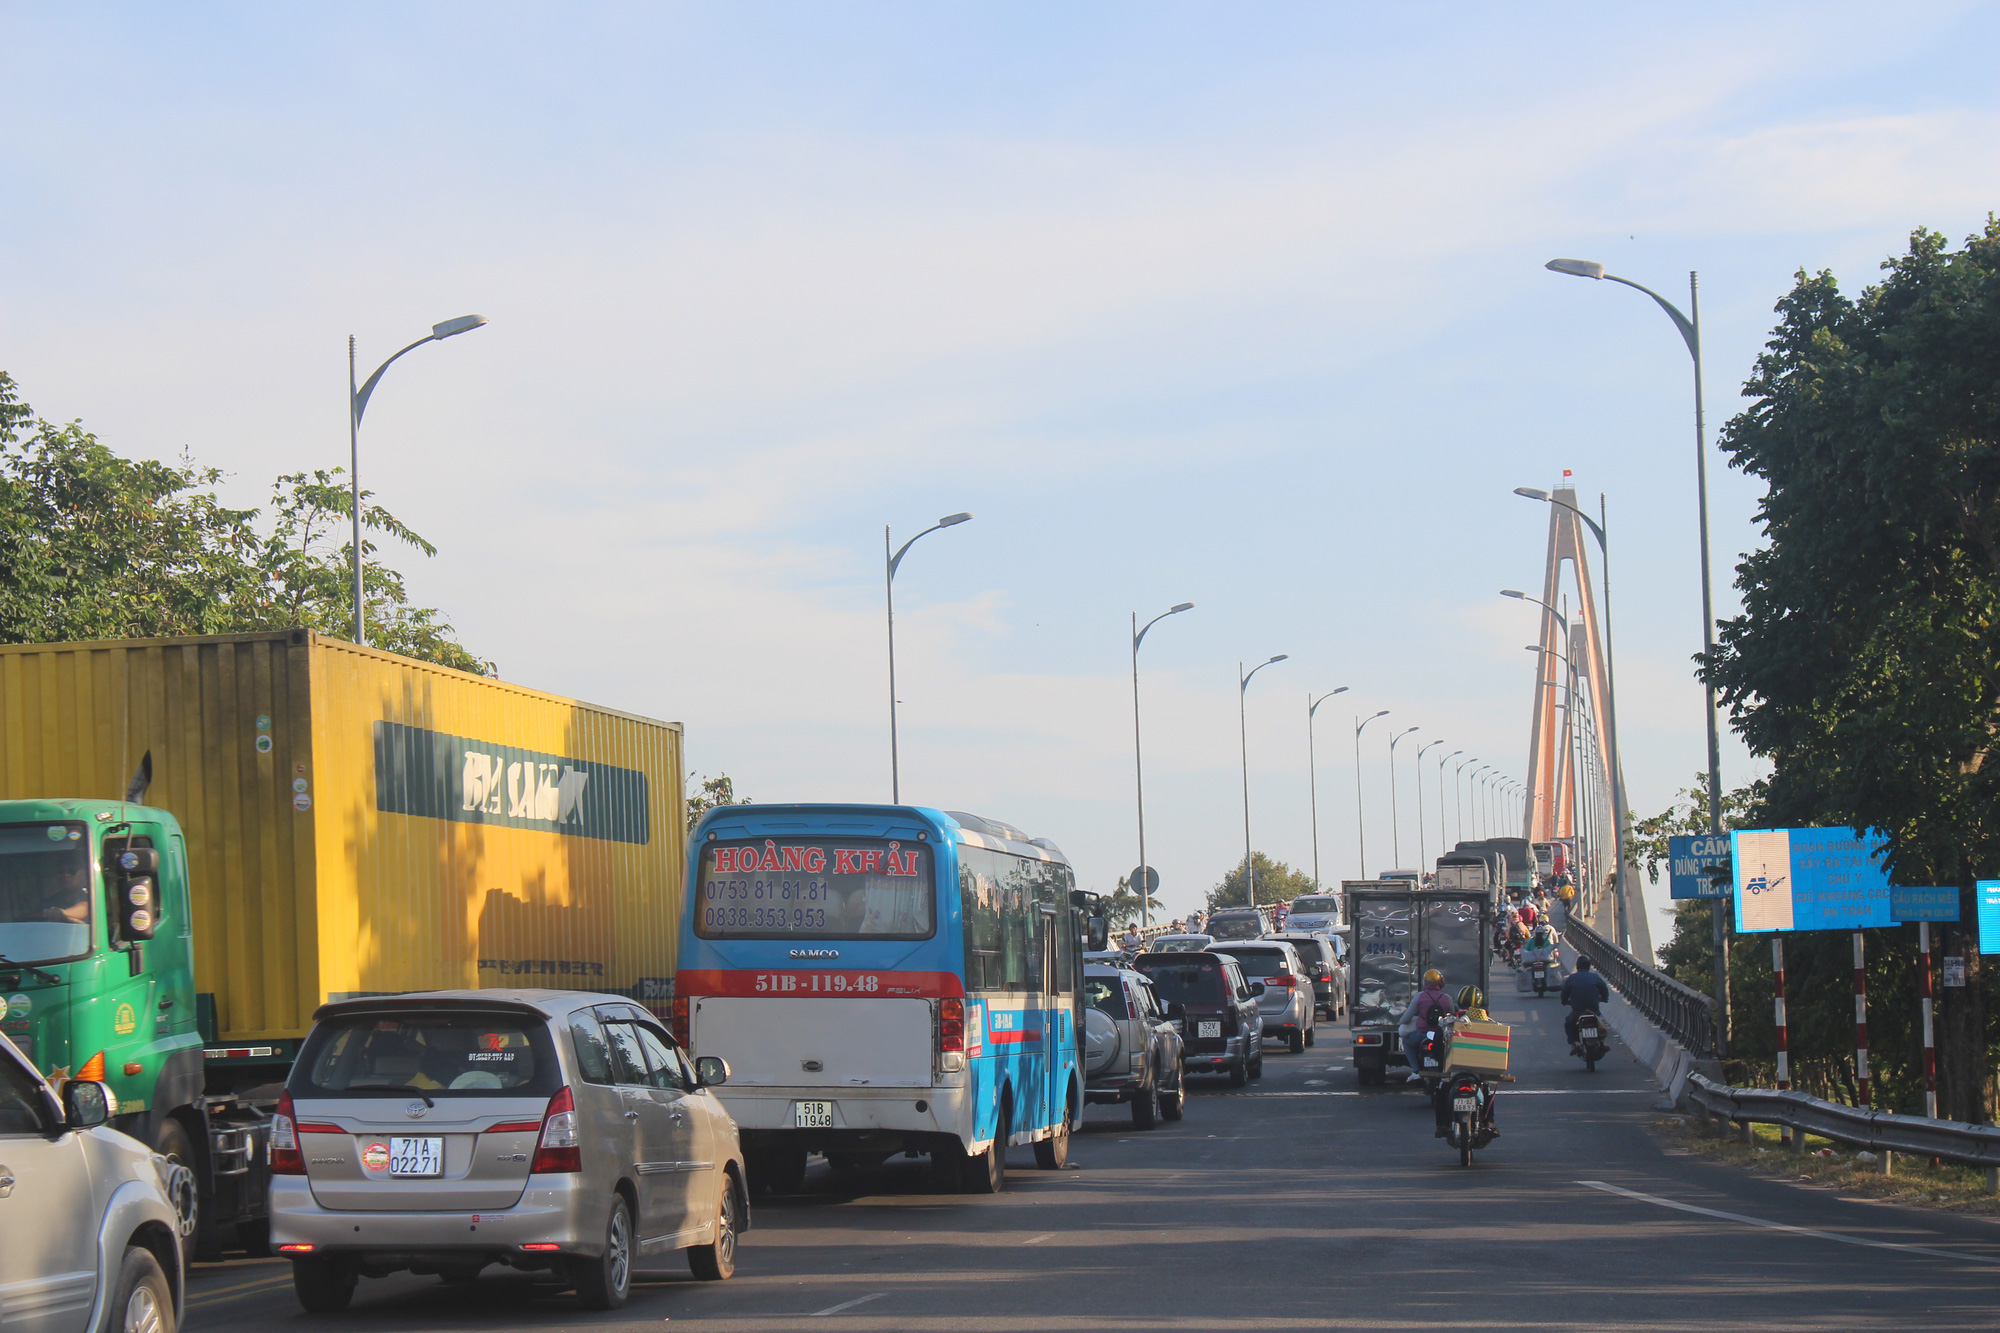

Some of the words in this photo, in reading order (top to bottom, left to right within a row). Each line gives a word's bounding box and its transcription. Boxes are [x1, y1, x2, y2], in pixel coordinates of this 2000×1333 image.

[1691, 837, 1732, 856] CẤM
[713, 839, 826, 873] HOÀNG
[833, 841, 918, 876] KHẢI
[1675, 855, 1699, 876] DỪNG
[1825, 857, 1840, 869] RA
[1844, 856, 1862, 867] TAI
[706, 881, 748, 900] 0753
[754, 881, 773, 899] 81
[781, 881, 828, 900] 81.81
[705, 908, 826, 927] 0838.353.953
[1822, 906, 1838, 917] AN
[1841, 903, 1872, 917] TOÀN
[789, 949, 840, 960] SAMCO
[1200, 1029, 1218, 1037] 3509
[804, 1103, 823, 1115] 51B
[402, 1139, 429, 1156] 71A
[390, 1156, 439, 1173] 022.71
